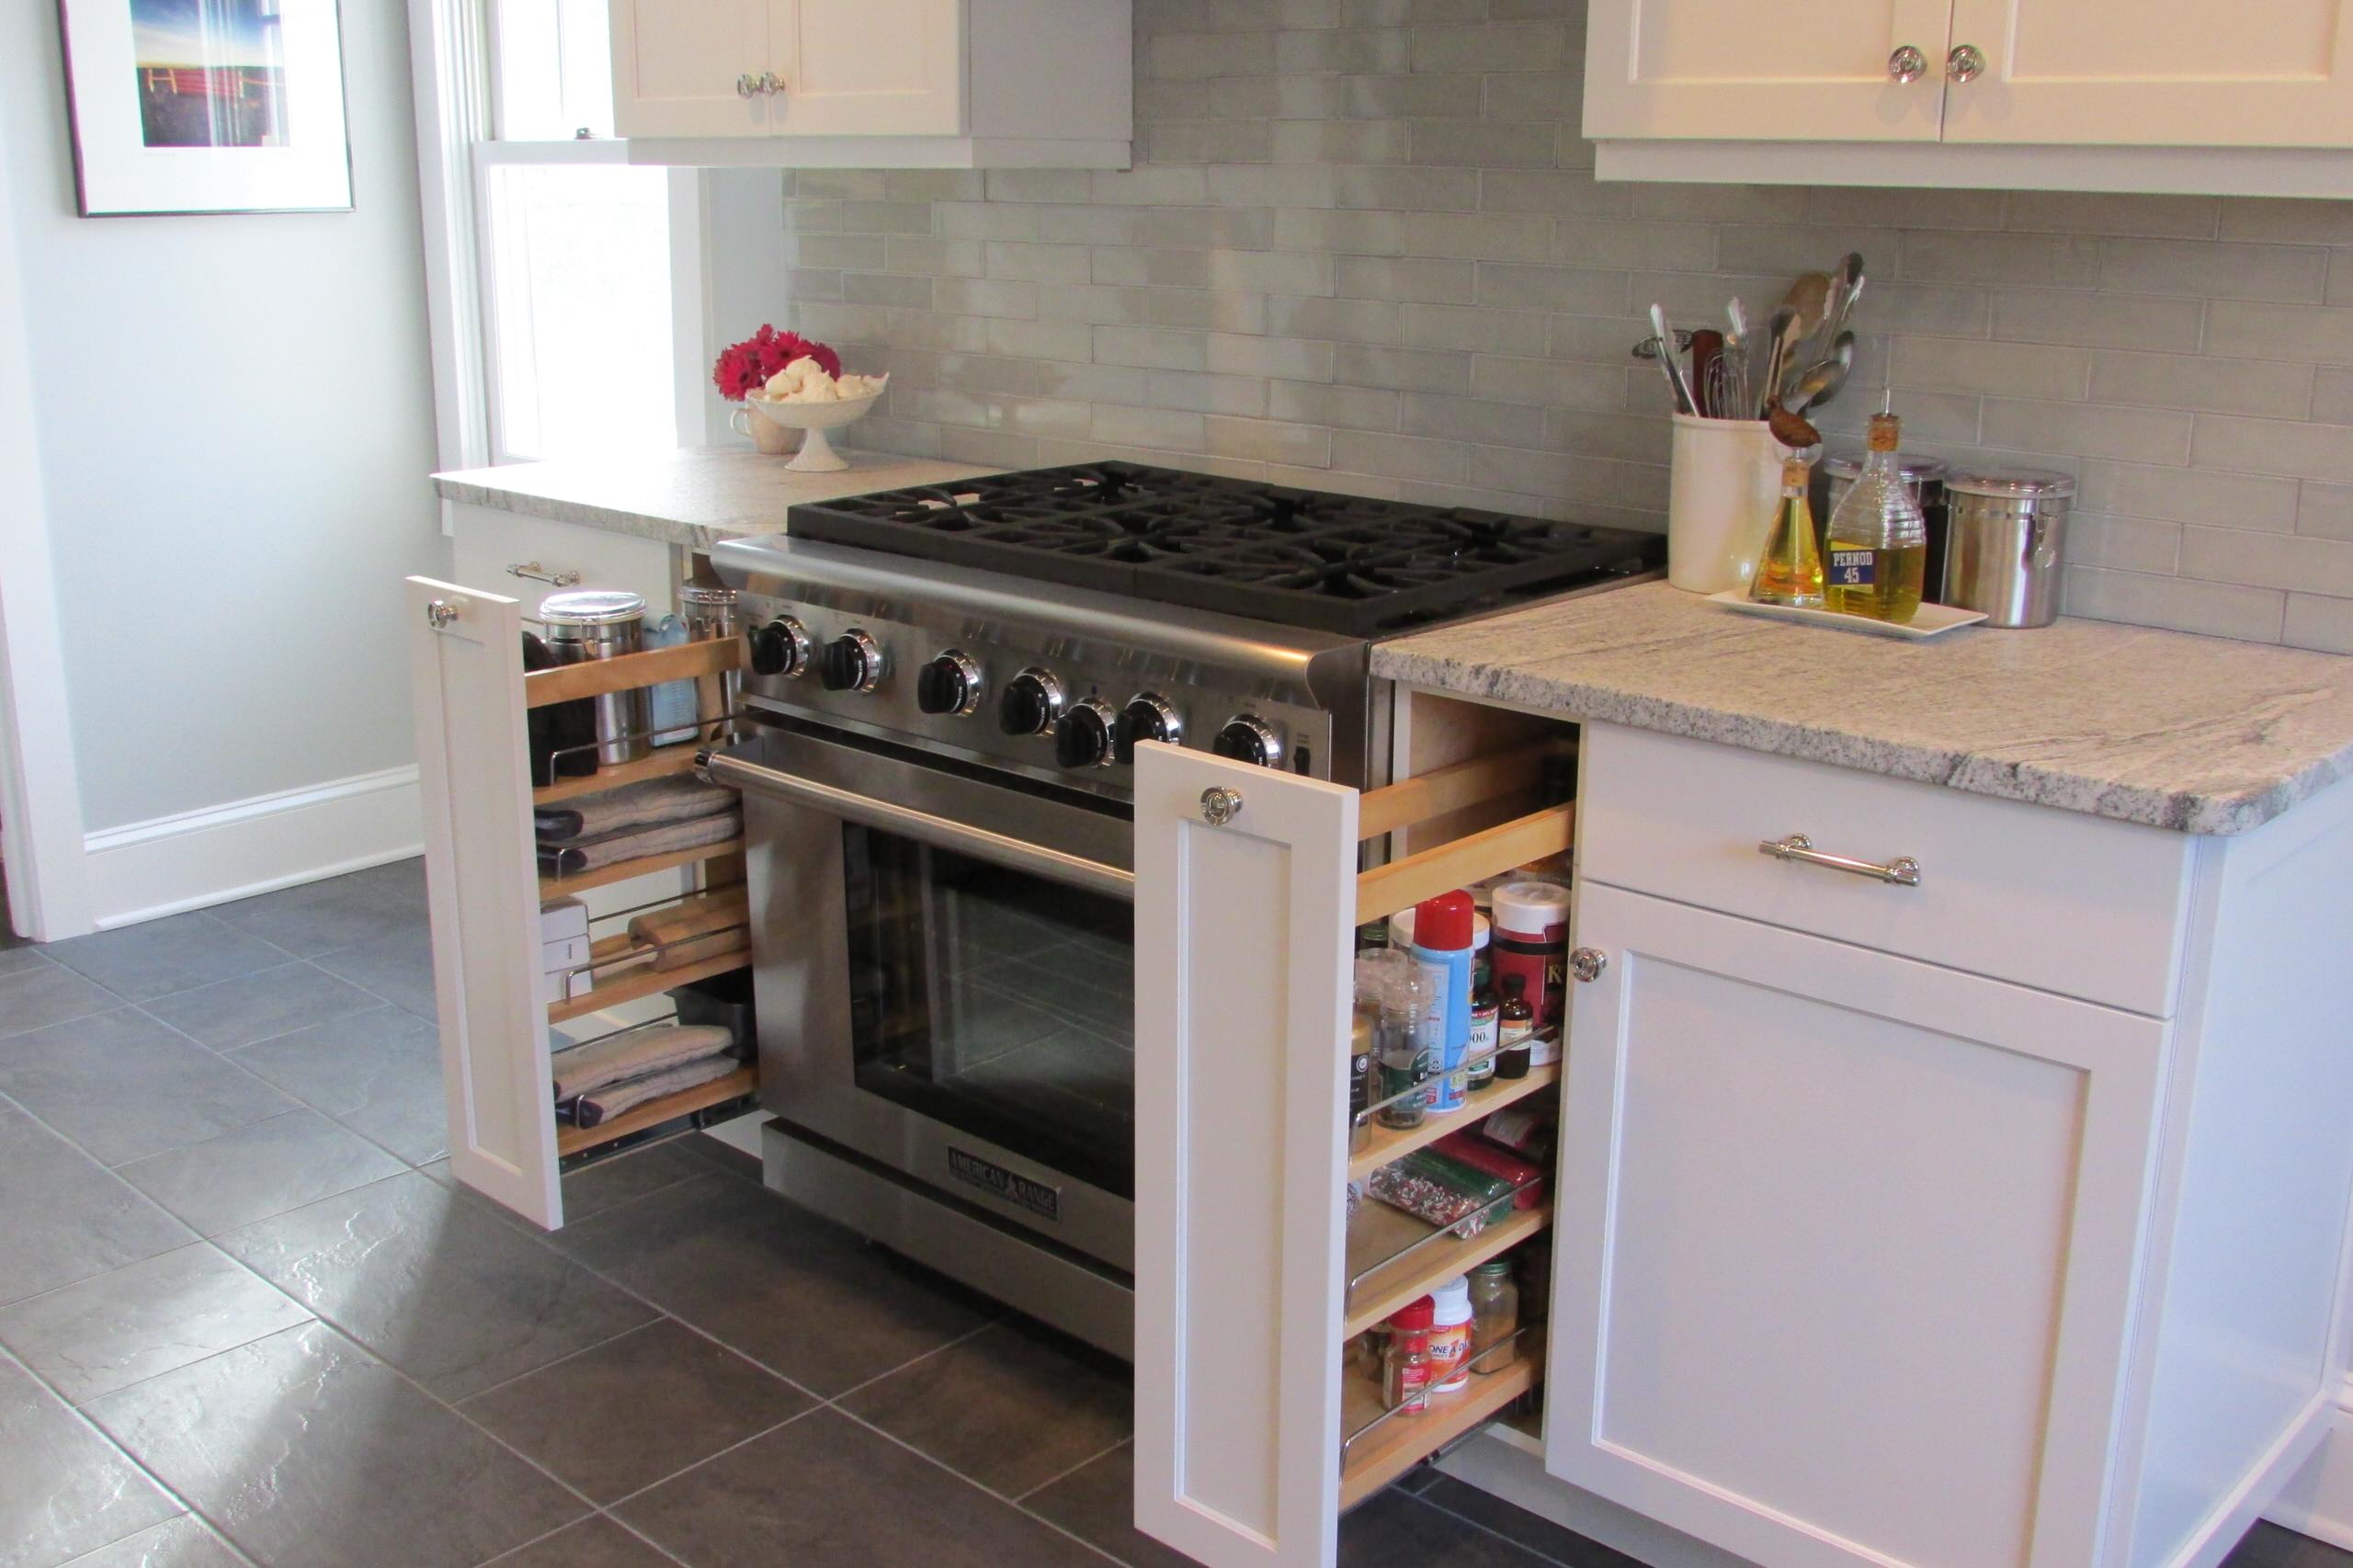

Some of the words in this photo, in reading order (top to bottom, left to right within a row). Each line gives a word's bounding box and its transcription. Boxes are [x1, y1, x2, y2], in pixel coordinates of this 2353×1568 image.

[1833, 551, 1873, 566] PERNOD
[1844, 567, 1859, 583] 45
[1470, 1031, 1486, 1044] 00
[950, 1150, 1006, 1189] AMERICAN
[1018, 1181, 1055, 1210] RANGE
[1428, 1345, 1449, 1354] ONE
